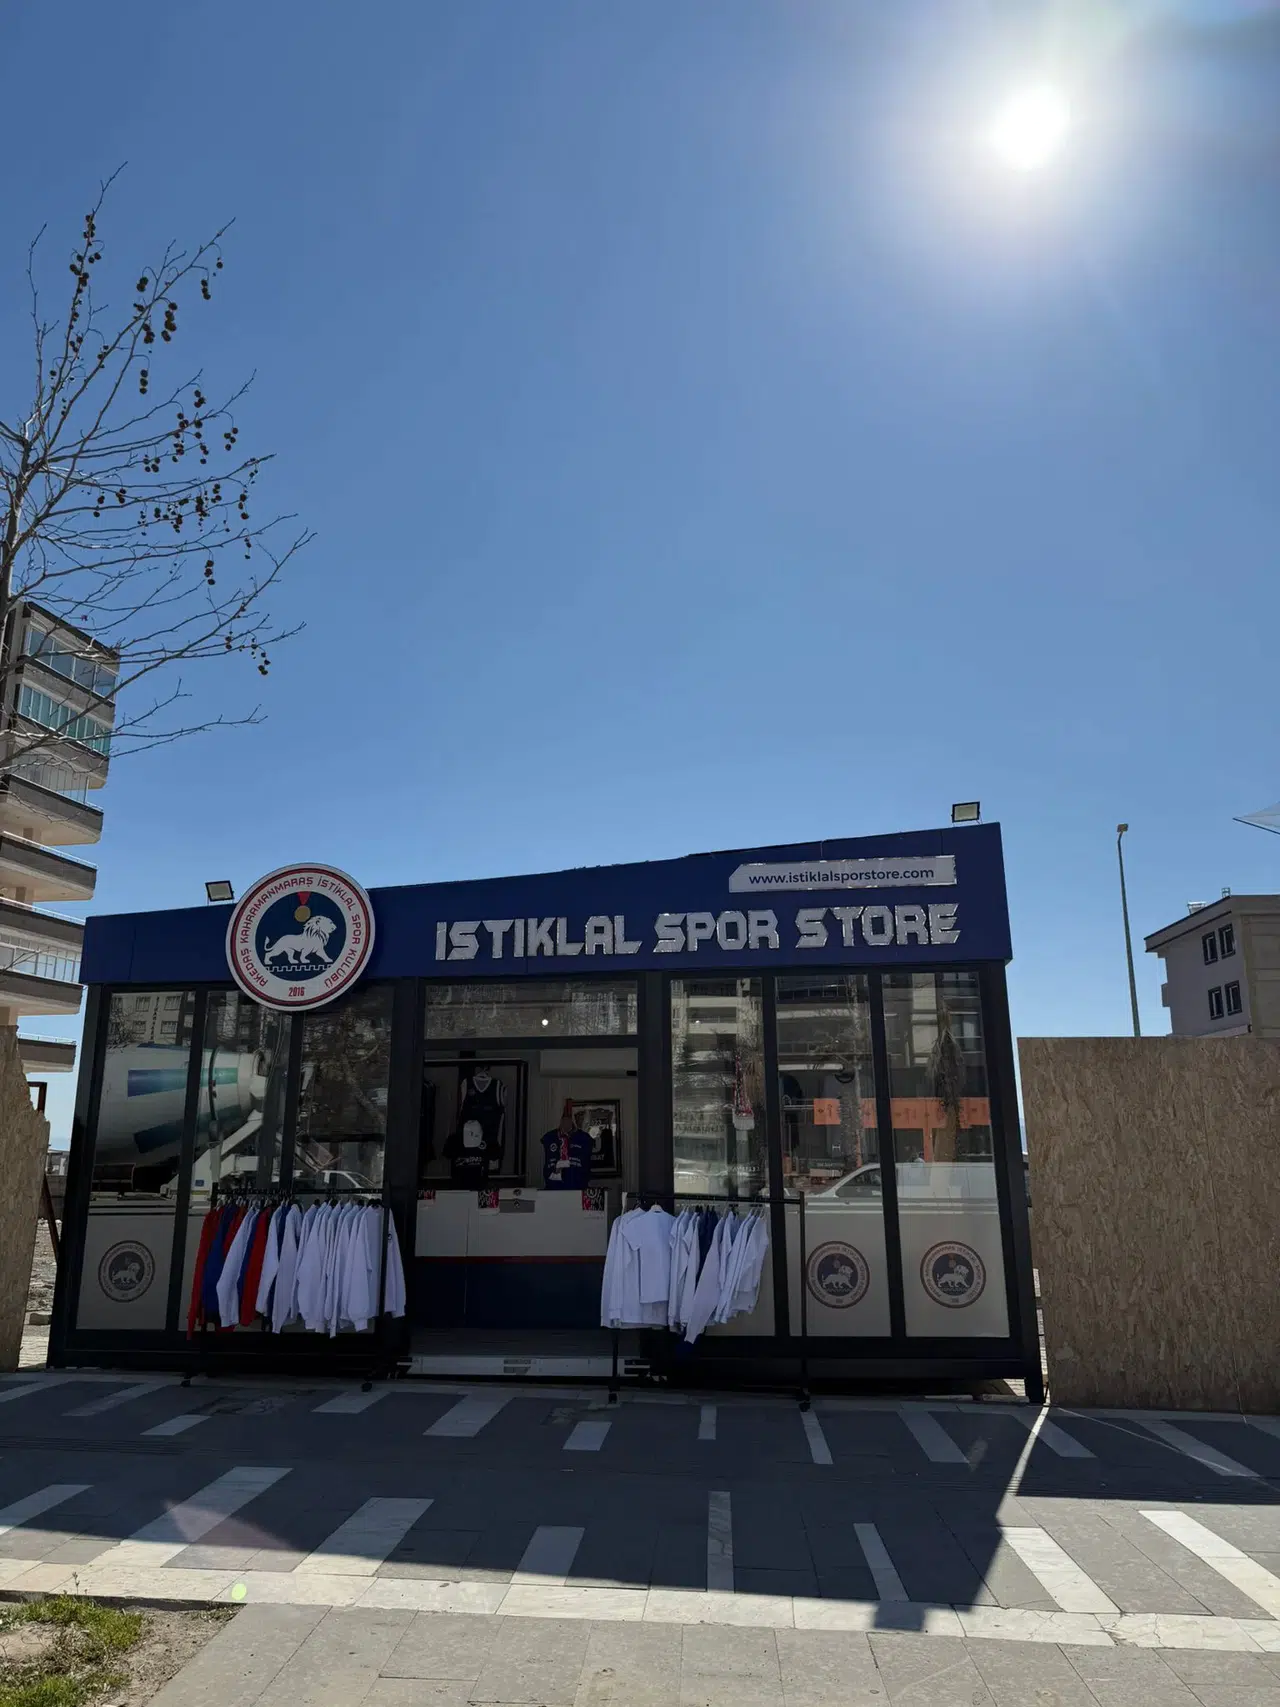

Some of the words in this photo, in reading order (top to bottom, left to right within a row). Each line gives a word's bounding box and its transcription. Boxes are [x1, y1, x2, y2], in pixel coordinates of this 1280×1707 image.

[317, 875, 356, 911] İSTİKLAL
[749, 867, 934, 885] www.istiklalsporstore.com
[240, 876, 314, 944] KAHRAMANMARAŞ
[351, 914, 362, 945] SPOR
[435, 915, 642, 960] ISTIKLAL
[652, 909, 780, 954] SPOR
[795, 902, 962, 949] STORE
[240, 947, 268, 987] AKEDAŞ
[324, 947, 358, 988] KULÜBÜ
[288, 986, 305, 997] 2016
